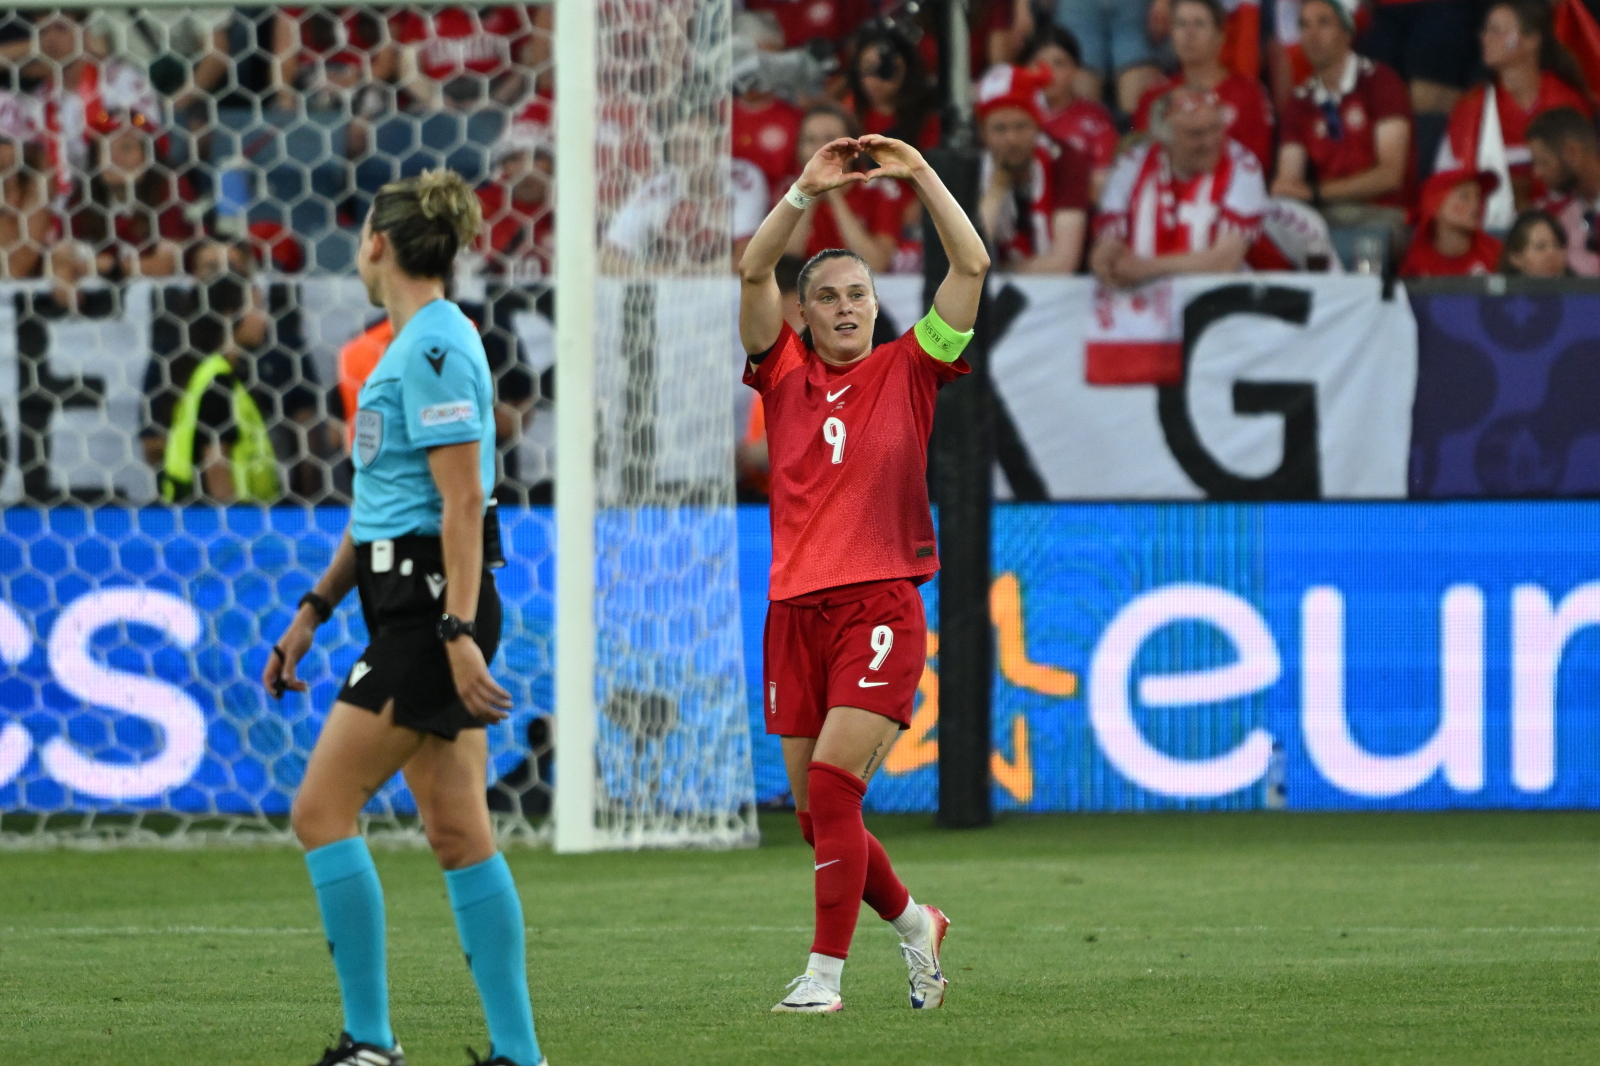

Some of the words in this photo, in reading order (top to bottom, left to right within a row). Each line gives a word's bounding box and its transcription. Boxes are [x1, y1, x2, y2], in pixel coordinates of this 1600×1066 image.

[925, 320, 941, 343] RESP
[823, 417, 847, 464] 9
[869, 625, 894, 671] 9
